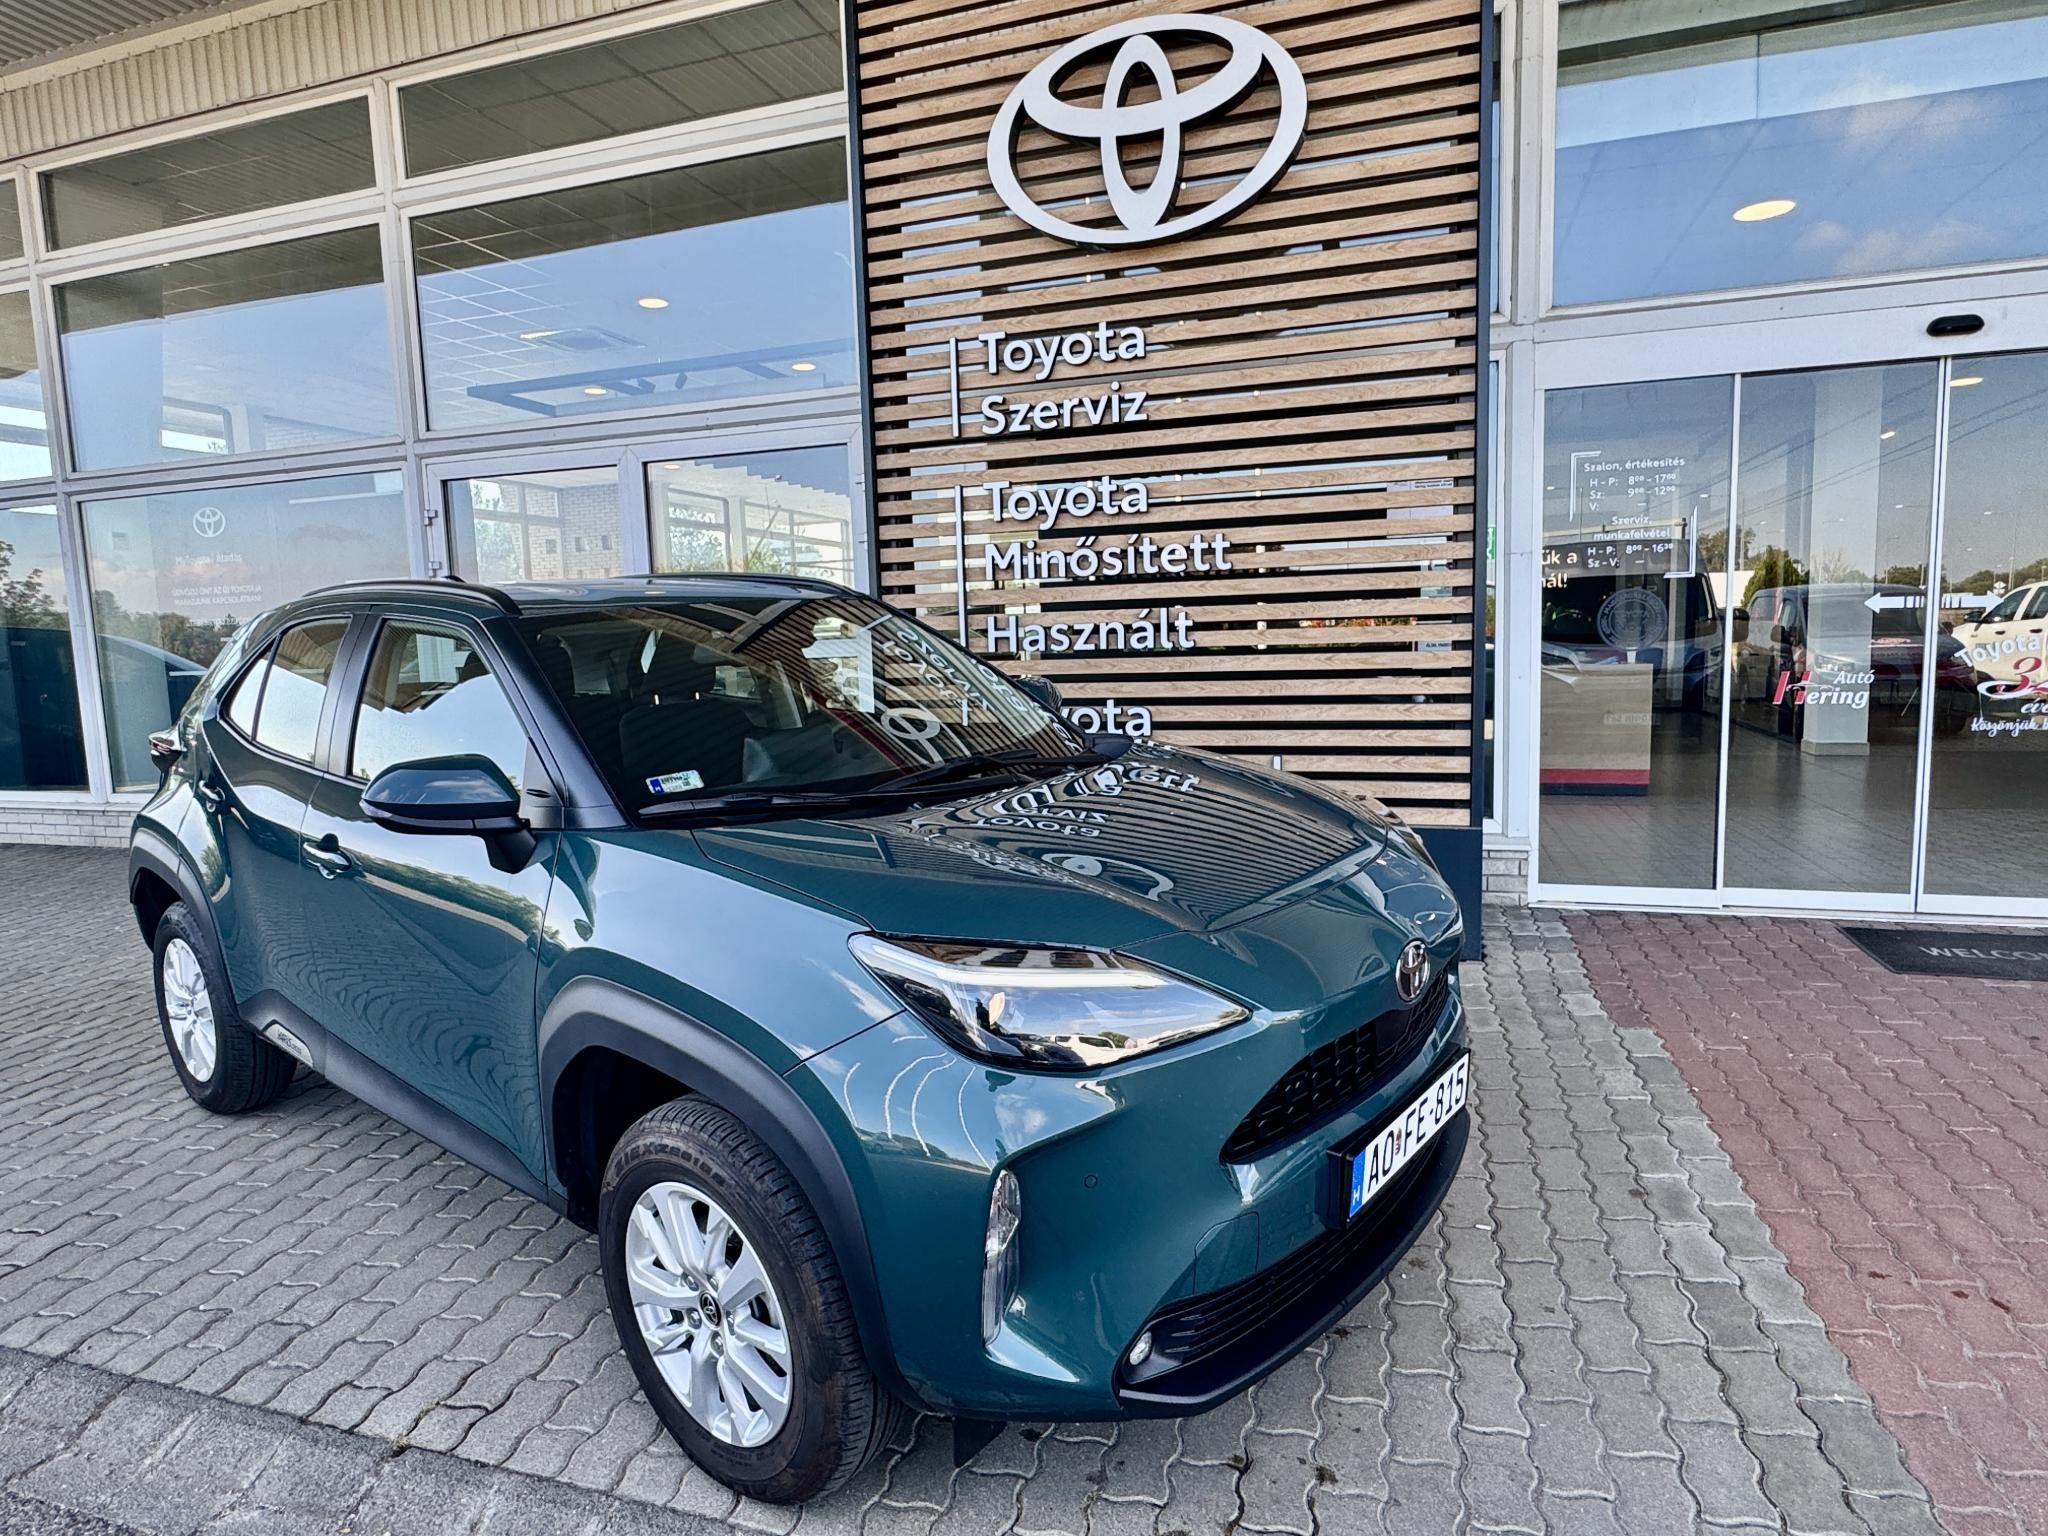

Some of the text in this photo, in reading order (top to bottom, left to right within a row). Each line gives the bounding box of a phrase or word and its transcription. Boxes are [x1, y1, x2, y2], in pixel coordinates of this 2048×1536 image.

[978, 321, 1147, 380] Toyota
[981, 381, 1148, 435] Szerviz
[1584, 457, 1685, 473] Szalon, értékesítés
[1590, 478, 1598, 487] H
[1608, 477, 1618, 486] P:
[983, 475, 1149, 530] Toyota
[1590, 490, 1605, 499] Sz:
[1589, 502, 1600, 511] V:
[1594, 527, 1670, 540] munkafelvétel
[984, 533, 1233, 580] Minősített
[1567, 552, 1577, 564] a
[1588, 547, 1596, 556] H
[1606, 546, 1616, 555] P:
[1588, 559, 1600, 568] Sz
[1609, 558, 1620, 567] V:
[987, 608, 1195, 652] Használt
[1954, 633, 2041, 667] Toyota
[1833, 670, 1876, 684] Autó
[1772, 671, 1870, 709] Hering
[1971, 717, 2038, 737] Köszönjük
[1368, 1062, 1466, 1193] AO FE-815
[1353, 1185, 1361, 1205] H
